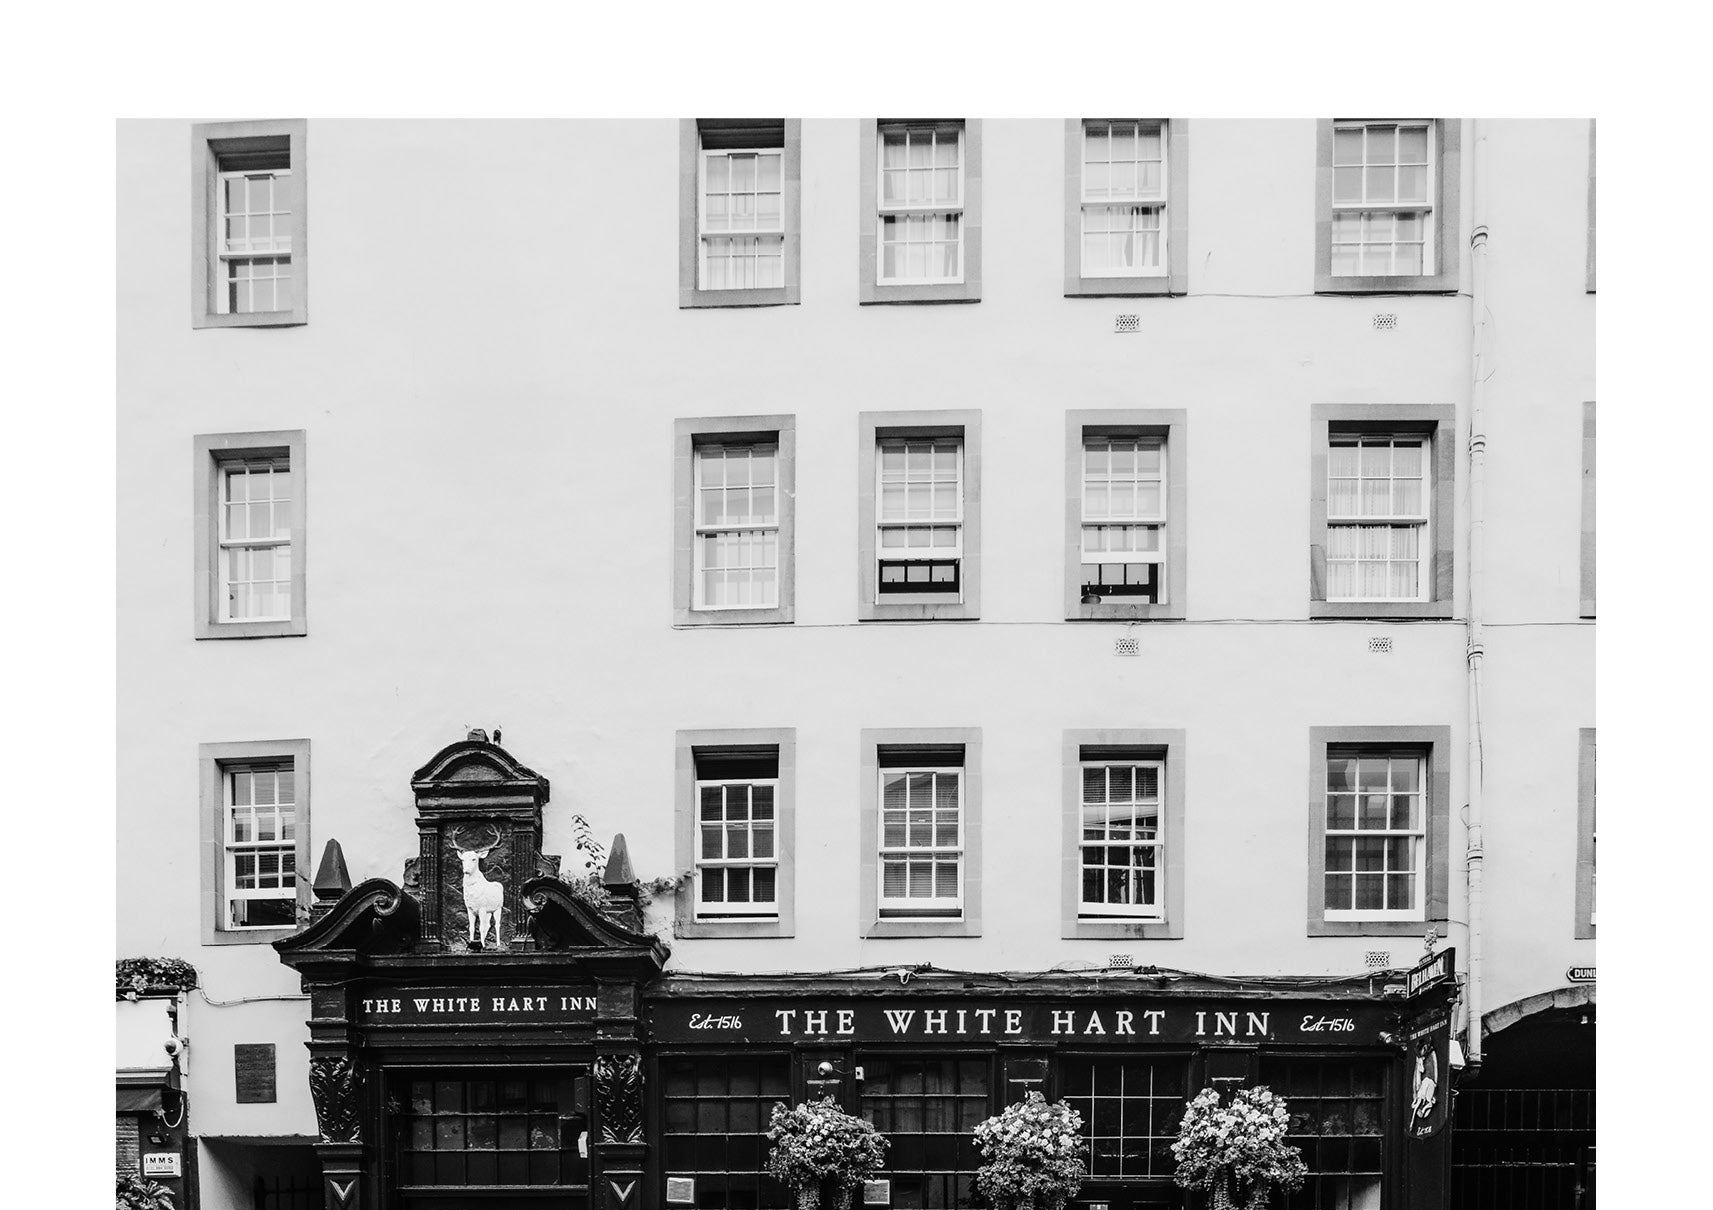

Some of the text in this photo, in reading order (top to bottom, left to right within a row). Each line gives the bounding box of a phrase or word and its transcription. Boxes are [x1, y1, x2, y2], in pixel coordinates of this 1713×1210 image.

[362, 996, 597, 1013] THE WHITE HART INN
[716, 1015, 742, 1029] 1516
[775, 1009, 1270, 1037] THE WHITE HART INN
[1327, 1017, 1355, 1032] 1516
